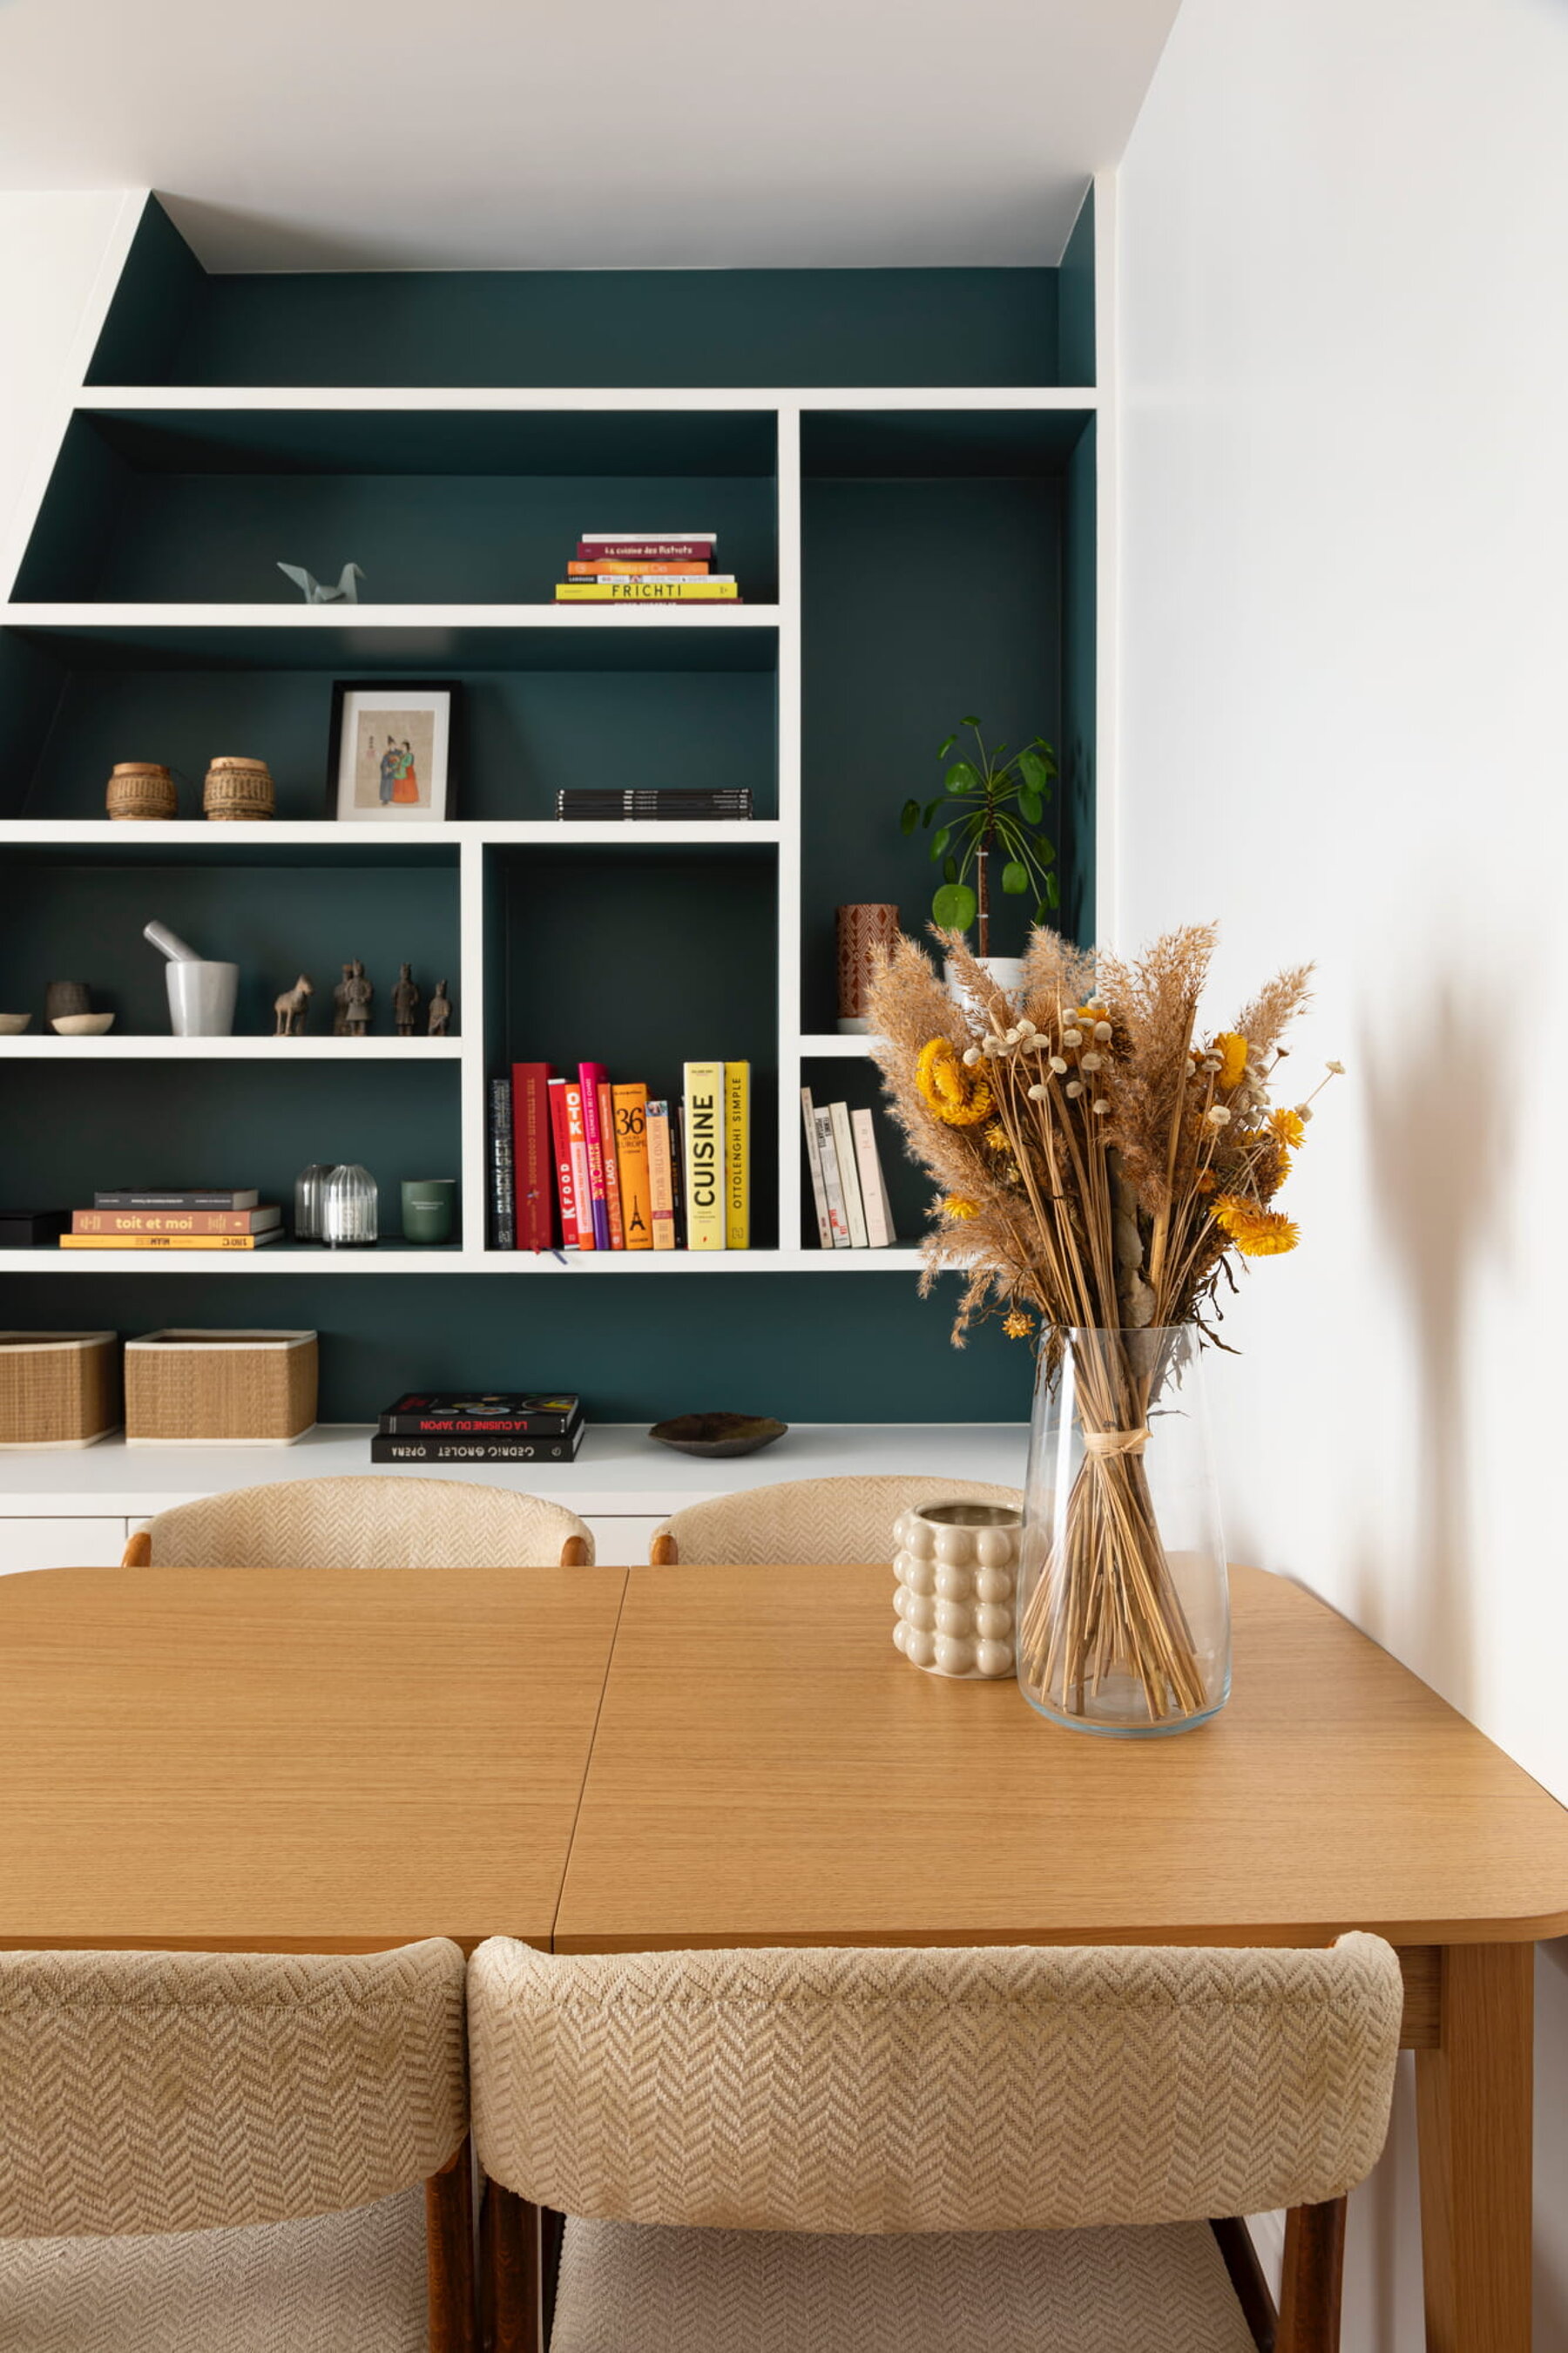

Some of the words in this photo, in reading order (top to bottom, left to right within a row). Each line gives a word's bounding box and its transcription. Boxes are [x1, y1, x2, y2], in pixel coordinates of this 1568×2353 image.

[644, 545, 658, 554] des
[612, 585, 681, 597] FRICHTI
[526, 1078, 535, 1095] THE
[732, 1077, 741, 1122] SIMPLE
[616, 1107, 644, 1135] 36
[528, 1137, 537, 1186] COOKBOOK
[693, 1095, 715, 1207] CUISINE
[605, 1159, 616, 1186] LAOS
[733, 1129, 742, 1209] OTTOLENGHI
[496, 1169, 511, 1214] BLACK
[115, 1215, 141, 1230] toit
[145, 1217, 161, 1230] et
[166, 1216, 193, 1230] moi
[607, 1191, 622, 1233] EASY
[420, 1420, 453, 1430] JAPON
[456, 1420, 470, 1430] DU
[470, 1420, 513, 1430] CUISINE
[514, 1420, 528, 1430] LA
